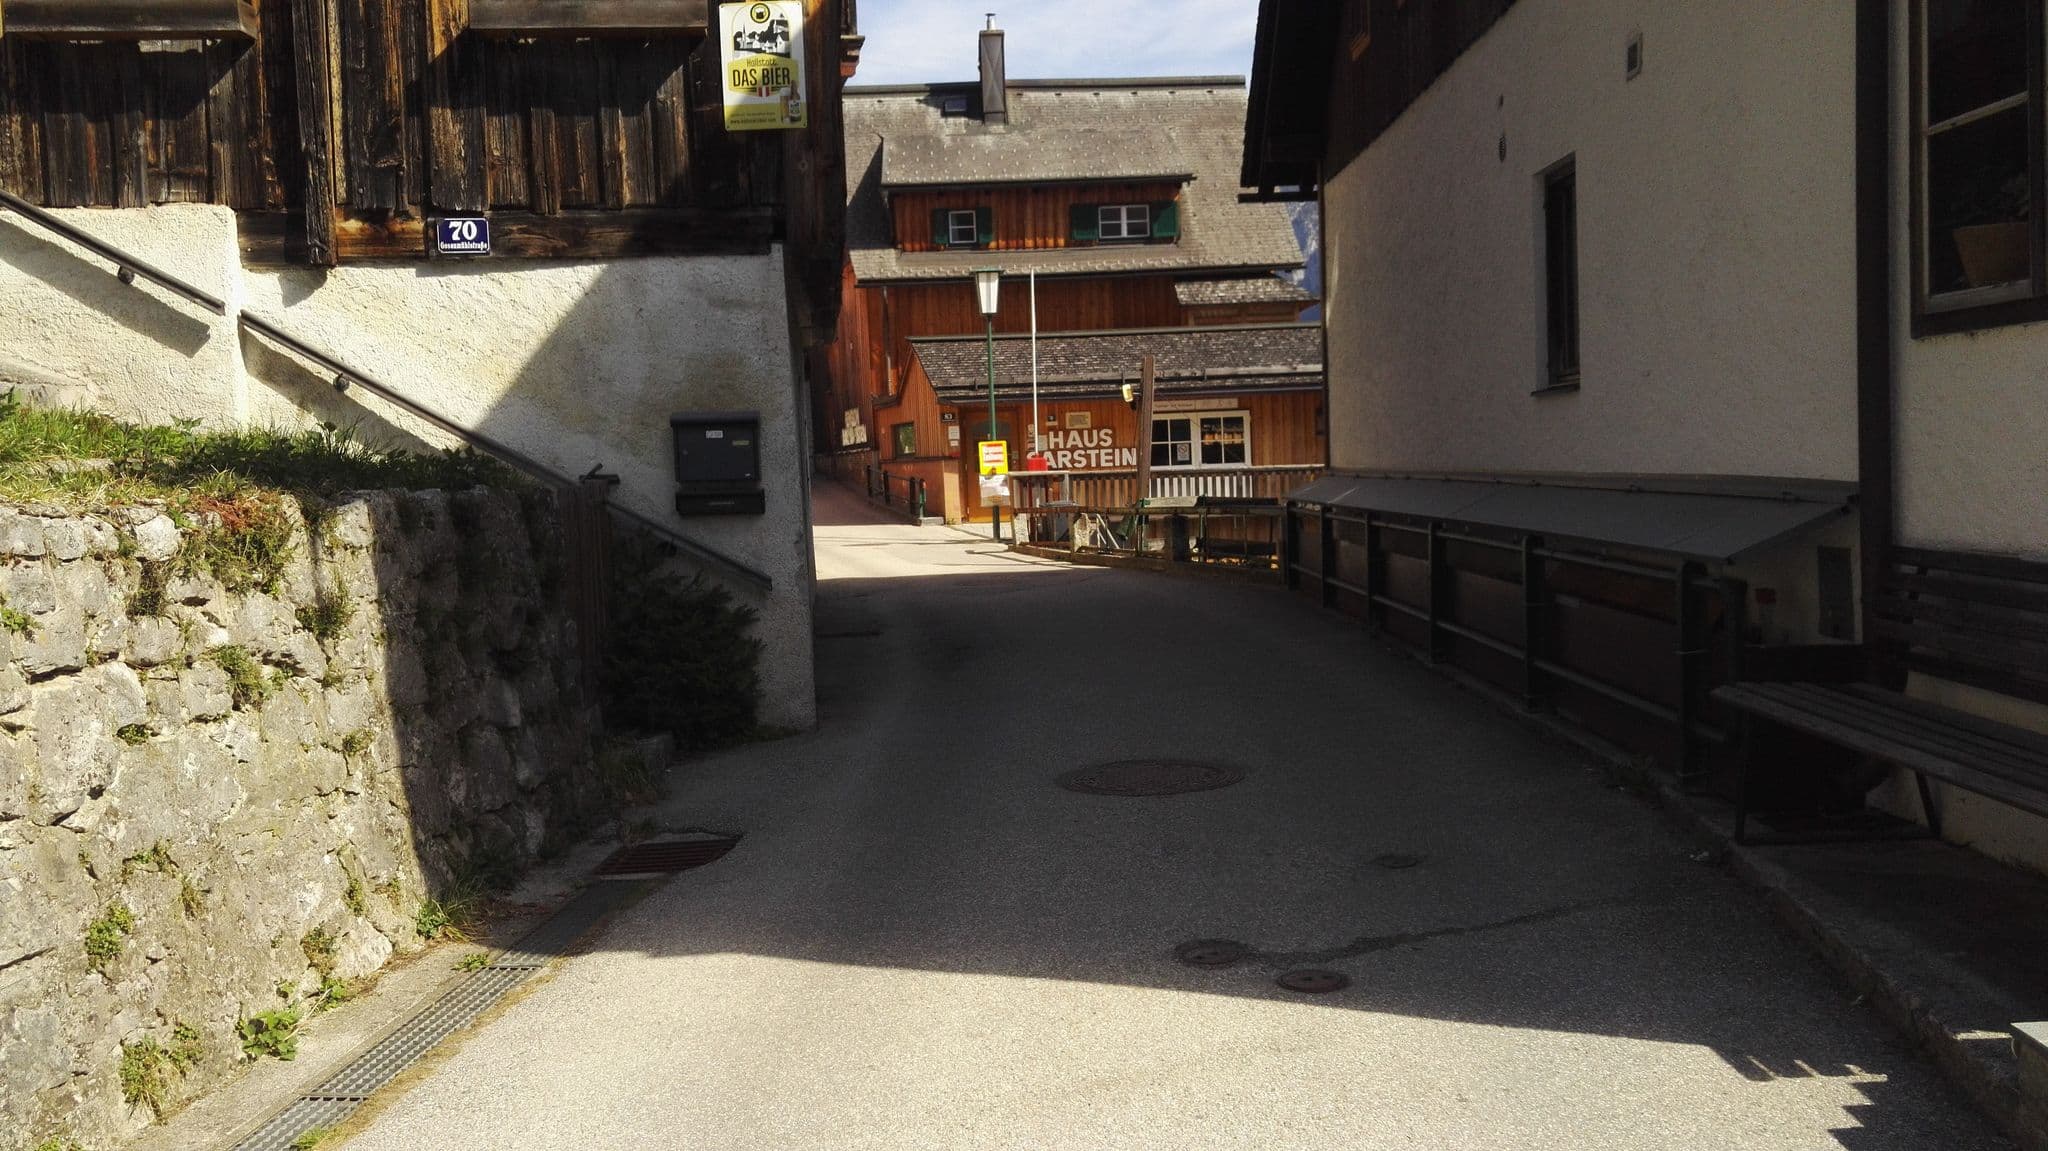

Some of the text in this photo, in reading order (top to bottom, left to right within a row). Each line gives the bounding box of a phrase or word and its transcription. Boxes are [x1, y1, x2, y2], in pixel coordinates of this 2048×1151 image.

[733, 67, 790, 87] DAS BIER
[448, 220, 478, 241] 70
[1049, 428, 1113, 449] HAUS
